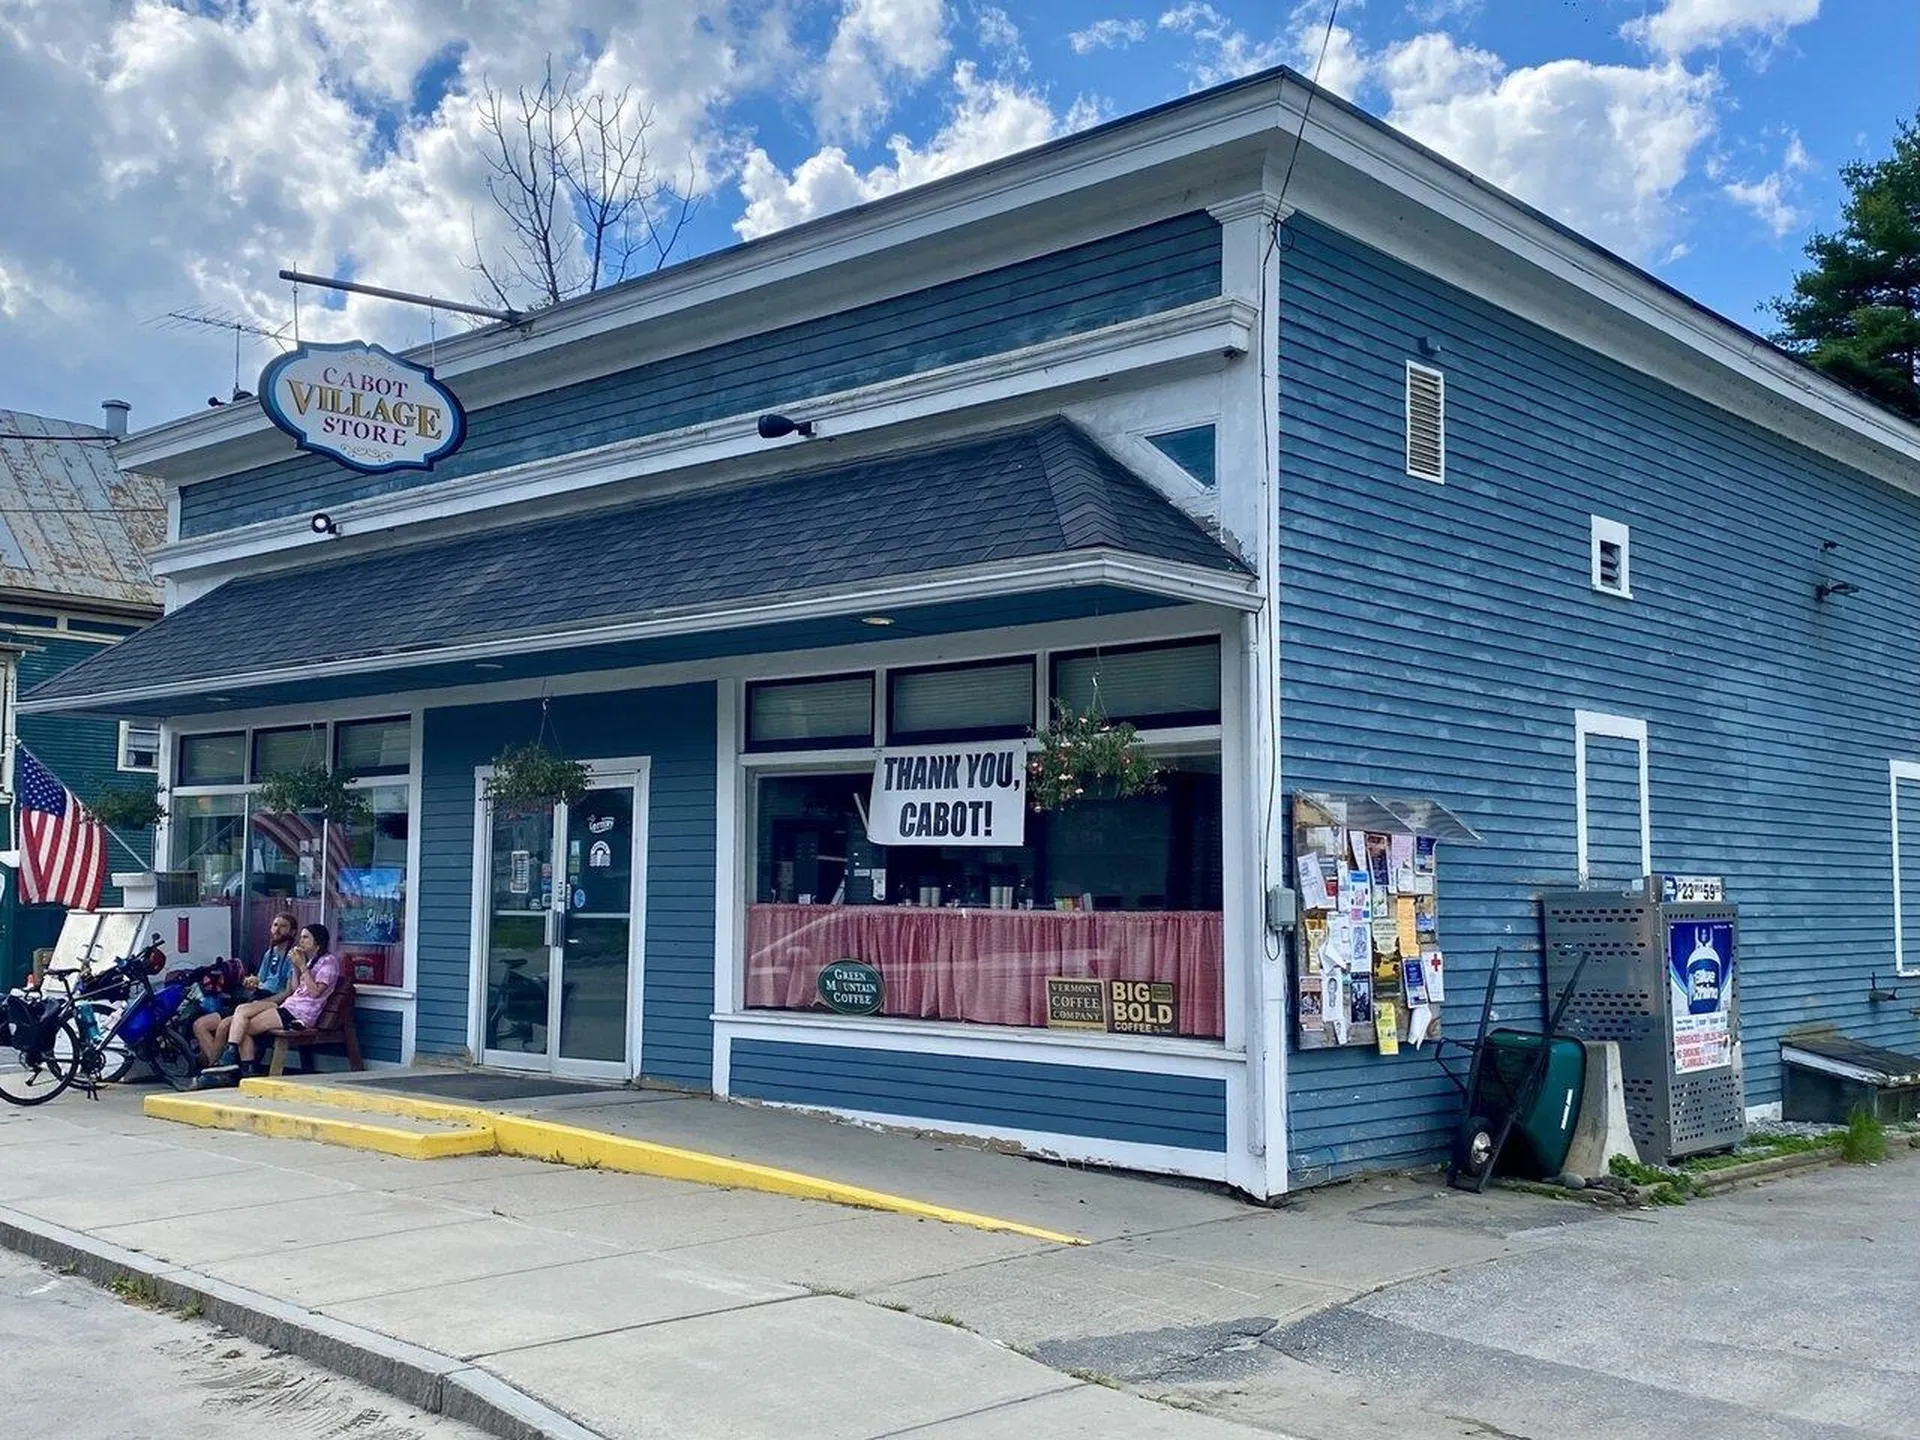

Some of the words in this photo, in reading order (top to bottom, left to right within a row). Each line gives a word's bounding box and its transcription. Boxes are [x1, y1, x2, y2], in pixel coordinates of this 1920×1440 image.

[322, 366, 408, 398] CABOT
[286, 378, 443, 440] VILLAGE
[322, 416, 407, 447] STORE
[884, 754, 961, 791] THANK
[966, 751, 1020, 791] YOU,
[899, 800, 993, 838] CABOT!
[833, 992, 873, 1005] COFFEE
[1050, 983, 1099, 993] VERMONT
[1111, 982, 1150, 1002] BIG
[1052, 995, 1100, 1009] COFFEE
[1112, 1001, 1173, 1024] BOLD
[1052, 1010, 1100, 1021] COMPANY
[1114, 1021, 1152, 1033] COFFEE
